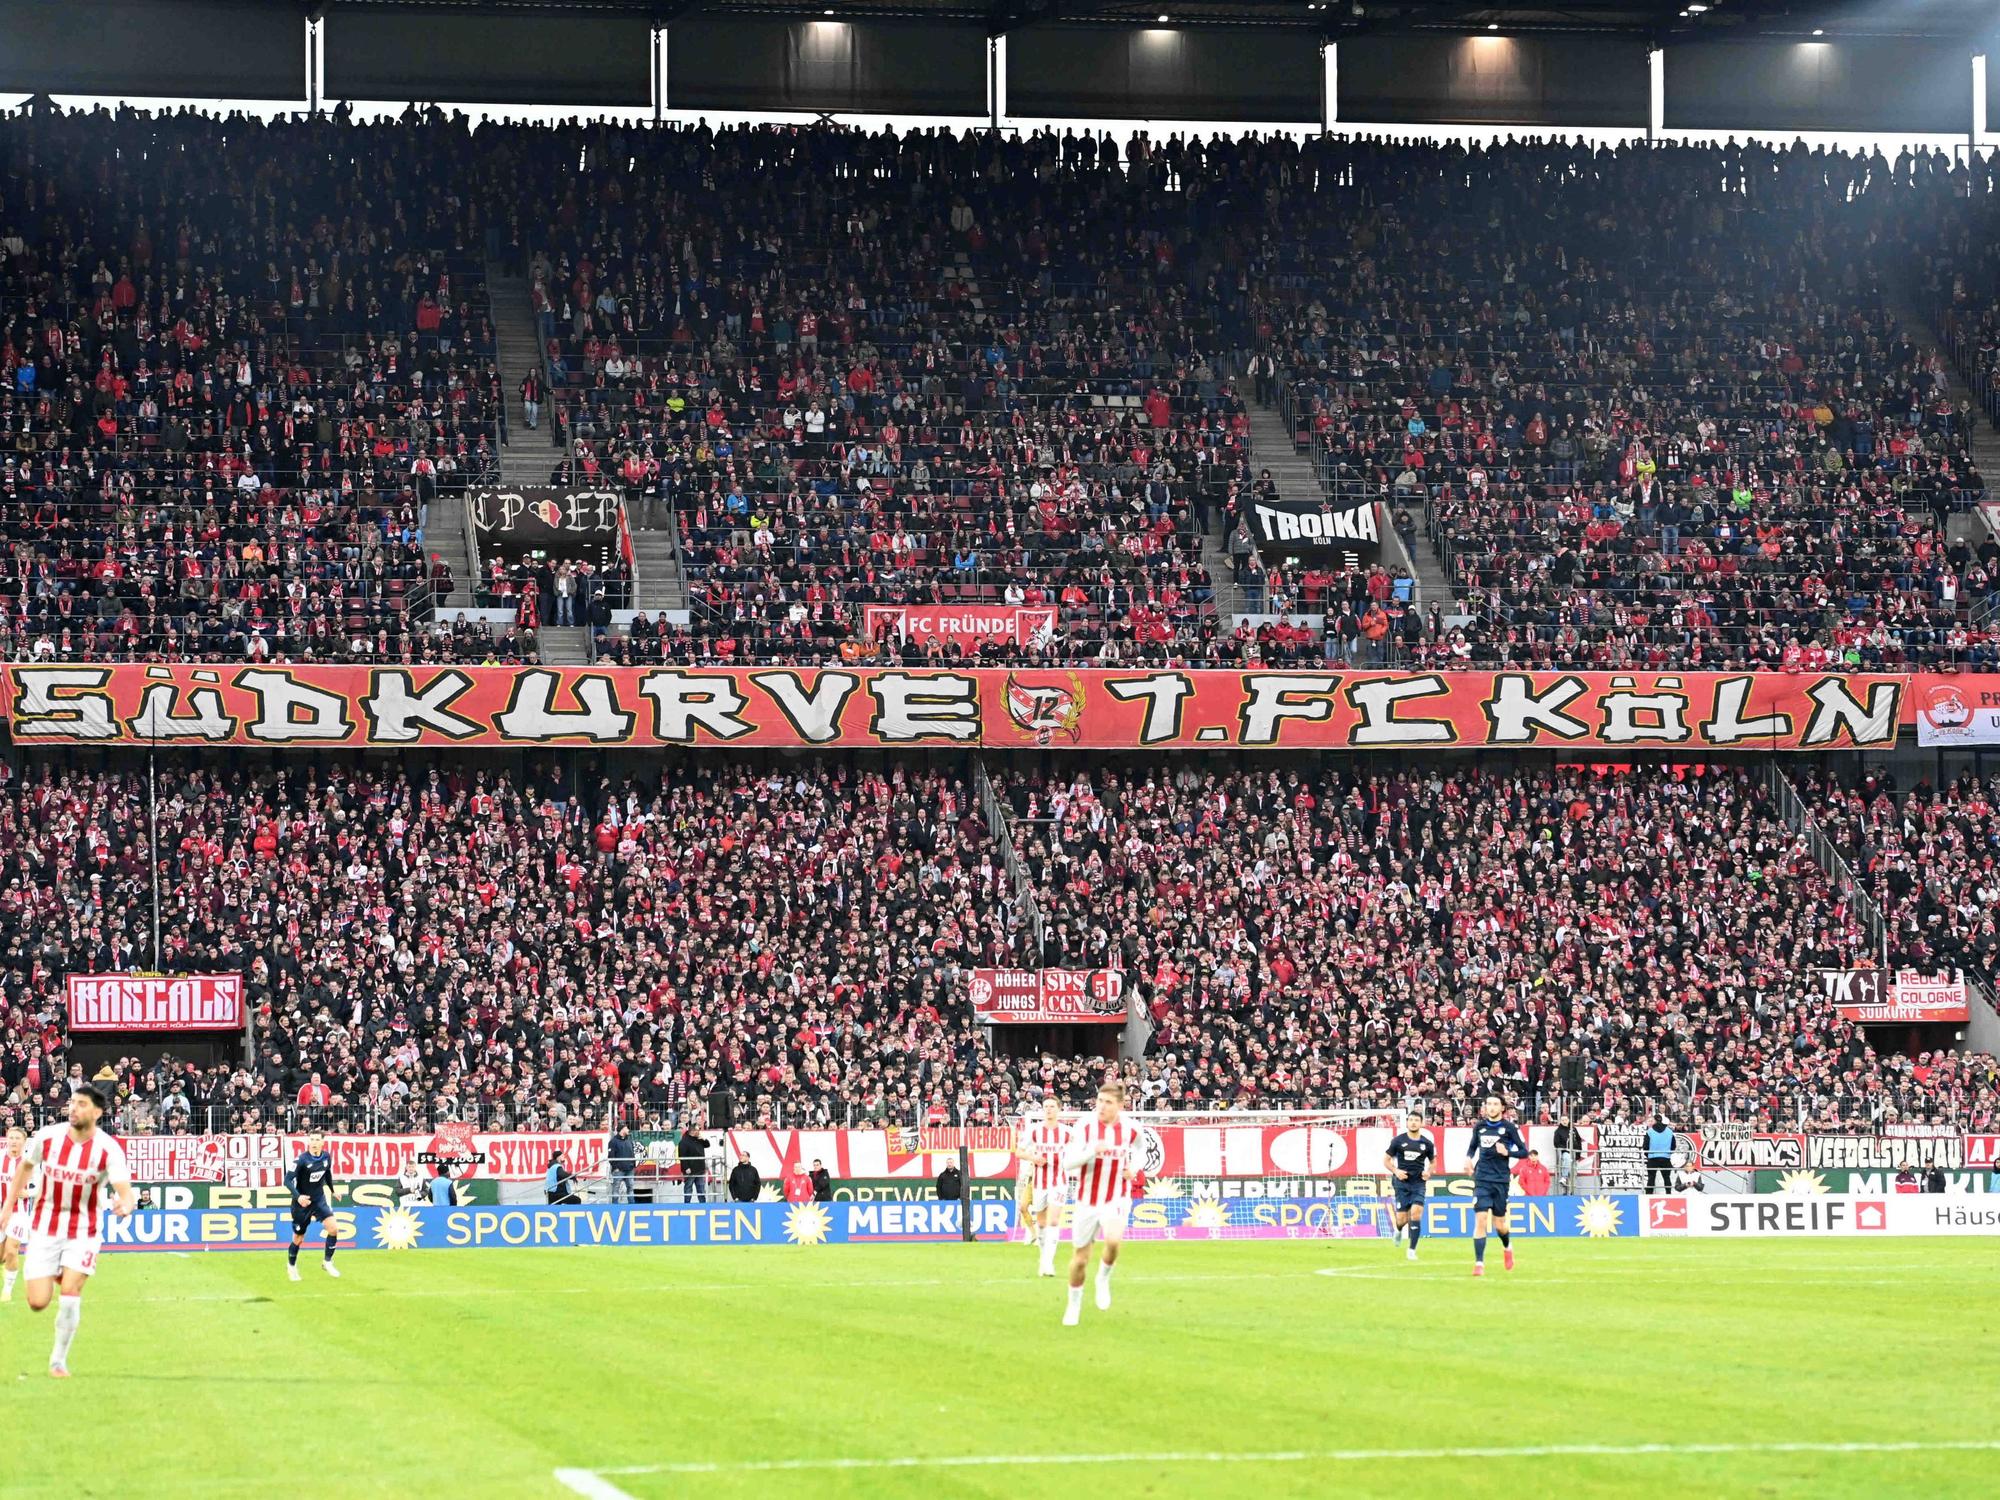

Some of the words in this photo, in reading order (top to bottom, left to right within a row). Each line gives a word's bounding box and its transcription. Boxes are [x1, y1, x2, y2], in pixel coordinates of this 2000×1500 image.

[1255, 502, 1379, 544] TROIKA
[1313, 536, 1331, 545] KÖLN
[909, 617, 932, 632] FC
[940, 614, 1015, 633] FRÜNDE
[11, 666, 980, 744] SÜDKURVE
[1033, 696, 1058, 721] 12
[1482, 673, 1900, 747] KÖLN
[995, 972, 1036, 987] HÖHER
[1047, 974, 1085, 991] SPS
[1095, 980, 1119, 997] 51
[1823, 972, 1857, 1001] TK
[75, 980, 235, 1022] RASCALS
[997, 997, 1035, 1009] JUNGS
[1048, 995, 1086, 1012] CGN
[1901, 991, 1961, 1003] COLOGNE
[1720, 1131, 1736, 1140] CON
[1739, 1131, 1752, 1140] NOI
[126, 1139, 197, 1159] SEMPER
[292, 1140, 415, 1175] MSTADT
[45, 1165, 83, 1183] REWE
[847, 1205, 1008, 1234] MERKUR
[1711, 1202, 1845, 1231] STREIF
[1936, 1206, 2000, 1225] Häus
[101, 1214, 190, 1243] KUR
[446, 1209, 761, 1244] SPORTWETTEN
